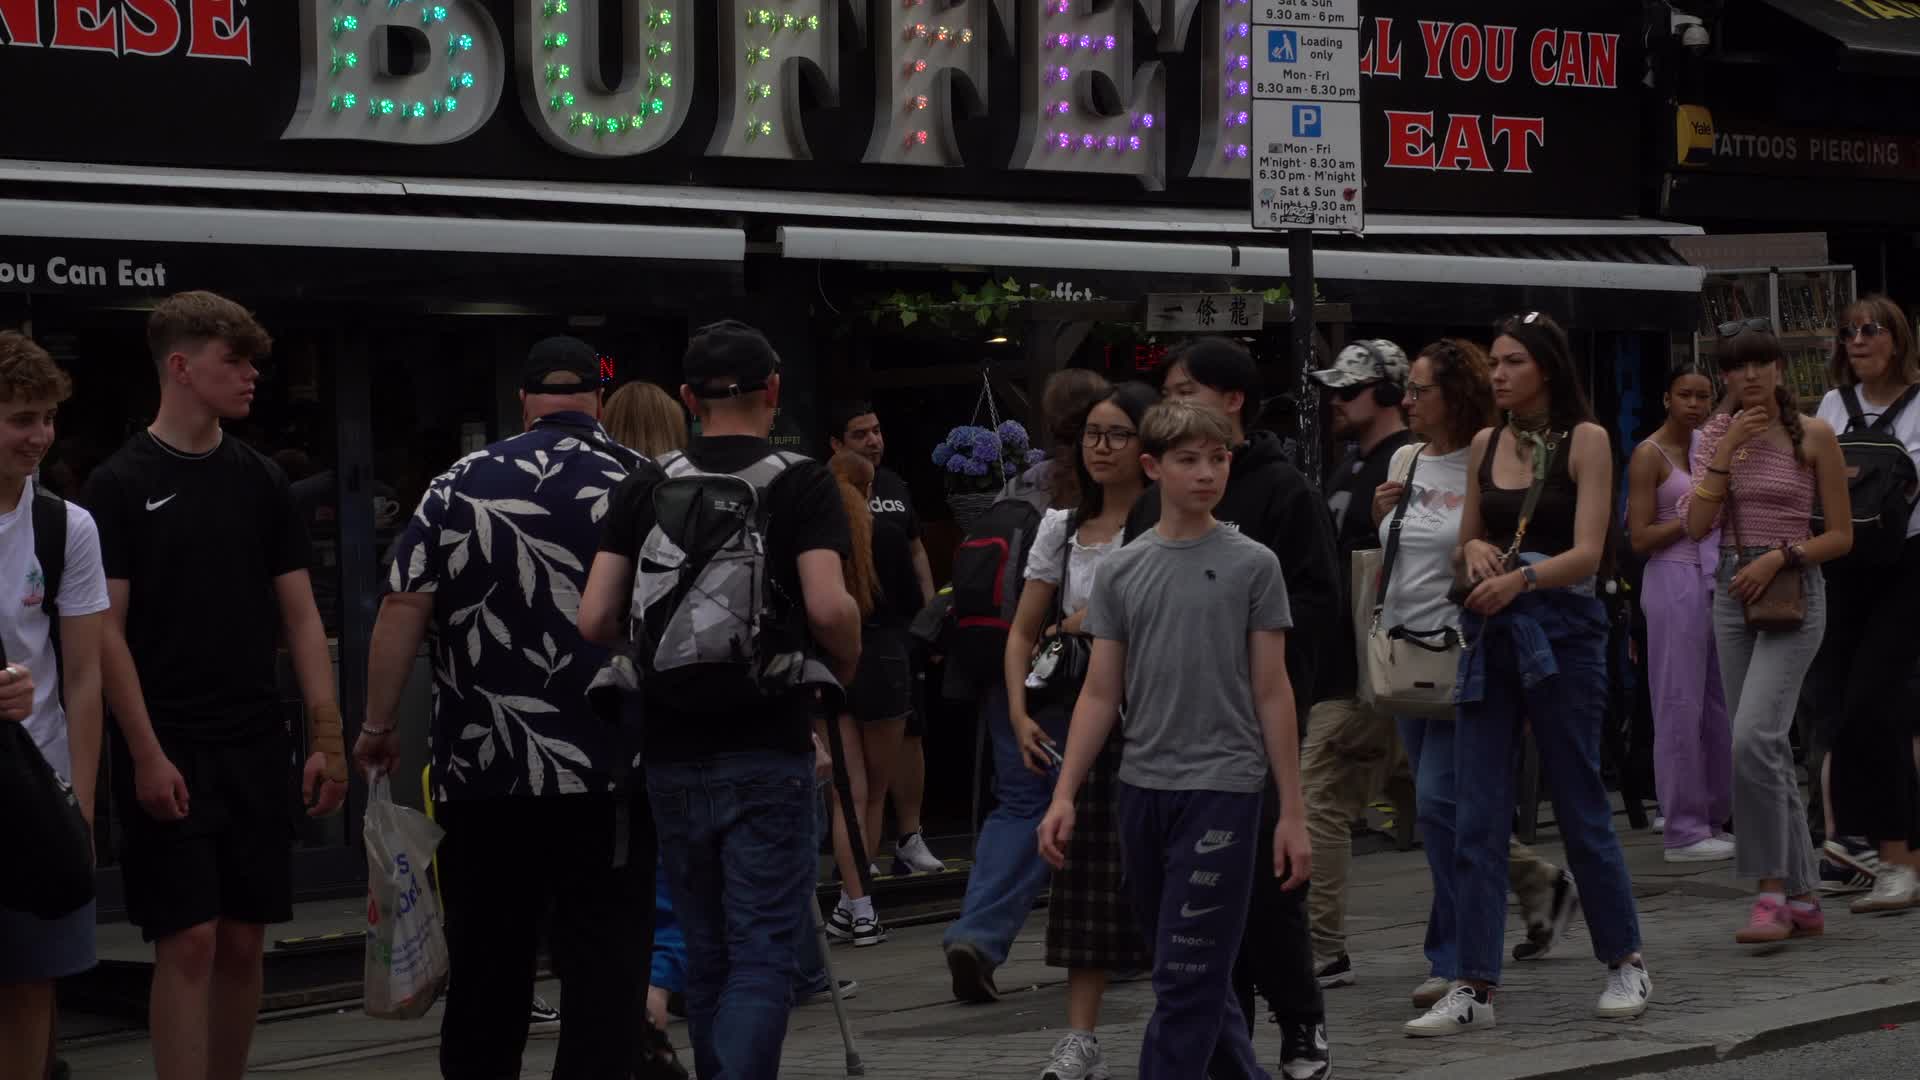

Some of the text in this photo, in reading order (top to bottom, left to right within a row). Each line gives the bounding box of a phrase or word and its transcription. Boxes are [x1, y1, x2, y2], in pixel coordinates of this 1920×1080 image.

[1266, 8, 1292, 20] 9.30
[1294, 12, 1310, 21] am
[1318, 11, 1326, 22] 6
[1328, 13, 1345, 23] pm
[1300, 35, 1343, 49] Loading
[1310, 50, 1334, 61] only
[1417, 19, 1518, 84] YOU
[1530, 27, 1620, 89] CAN
[1283, 69, 1307, 80] Mon
[1315, 70, 1330, 81] Fri
[1257, 82, 1284, 93] 8.30
[1286, 85, 1302, 94] am
[1310, 84, 1337, 95] 6.30
[1339, 87, 1356, 97] pm
[1690, 121, 1712, 135] Yale
[1284, 143, 1307, 154] Mon
[1316, 144, 1331, 154] Fri
[1383, 110, 1545, 173] EAT
[1808, 138, 1900, 166] PIERCING
[1260, 157, 1301, 169] M'night
[1310, 158, 1337, 169] 8.30
[1339, 161, 1355, 169] am
[1259, 169, 1286, 180] 6.30
[1288, 172, 1305, 182] pm
[1314, 171, 1356, 183] M'night
[1280, 186, 1336, 197] Sat & Sun
[1311, 201, 1337, 211] 9.30
[1339, 203, 1356, 211] am
[47, 256, 107, 286] Can
[118, 258, 167, 287] Eat
[1188, 869, 1223, 887] NIKE
